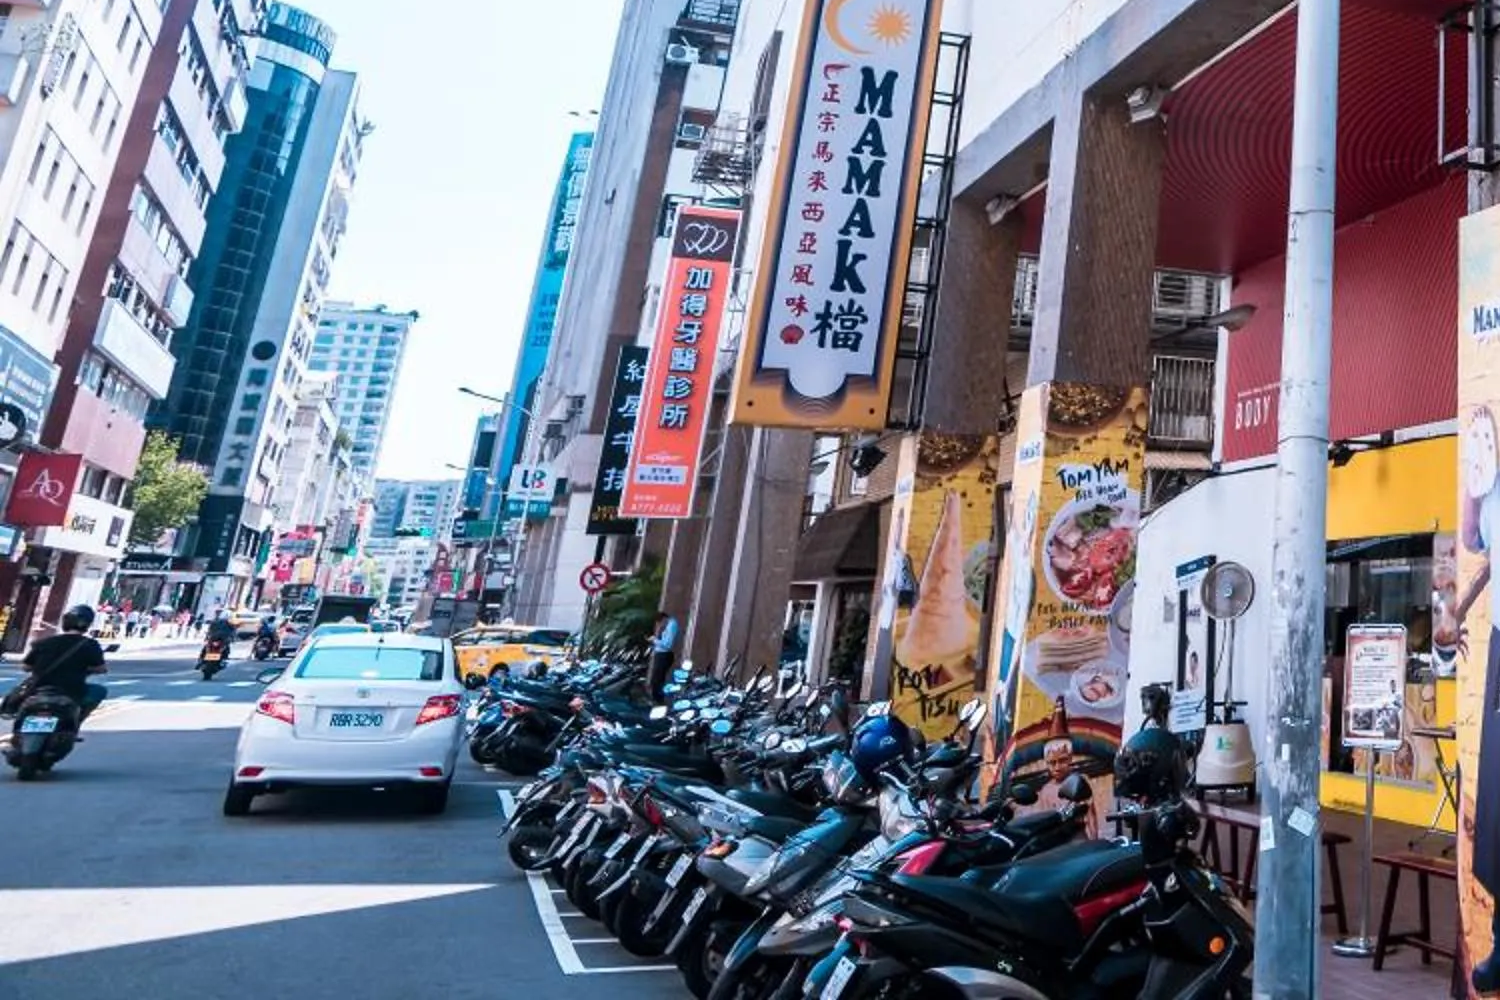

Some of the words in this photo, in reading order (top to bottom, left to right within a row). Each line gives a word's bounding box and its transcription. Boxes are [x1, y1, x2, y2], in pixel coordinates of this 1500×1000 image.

[784, 82, 842, 318] 正宗馬來西亞風味
[658, 266, 715, 430] 加得牙醫診所
[1234, 395, 1271, 431] BODY
[1055, 468, 1091, 492] TOM
[1092, 457, 1129, 483] YAM
